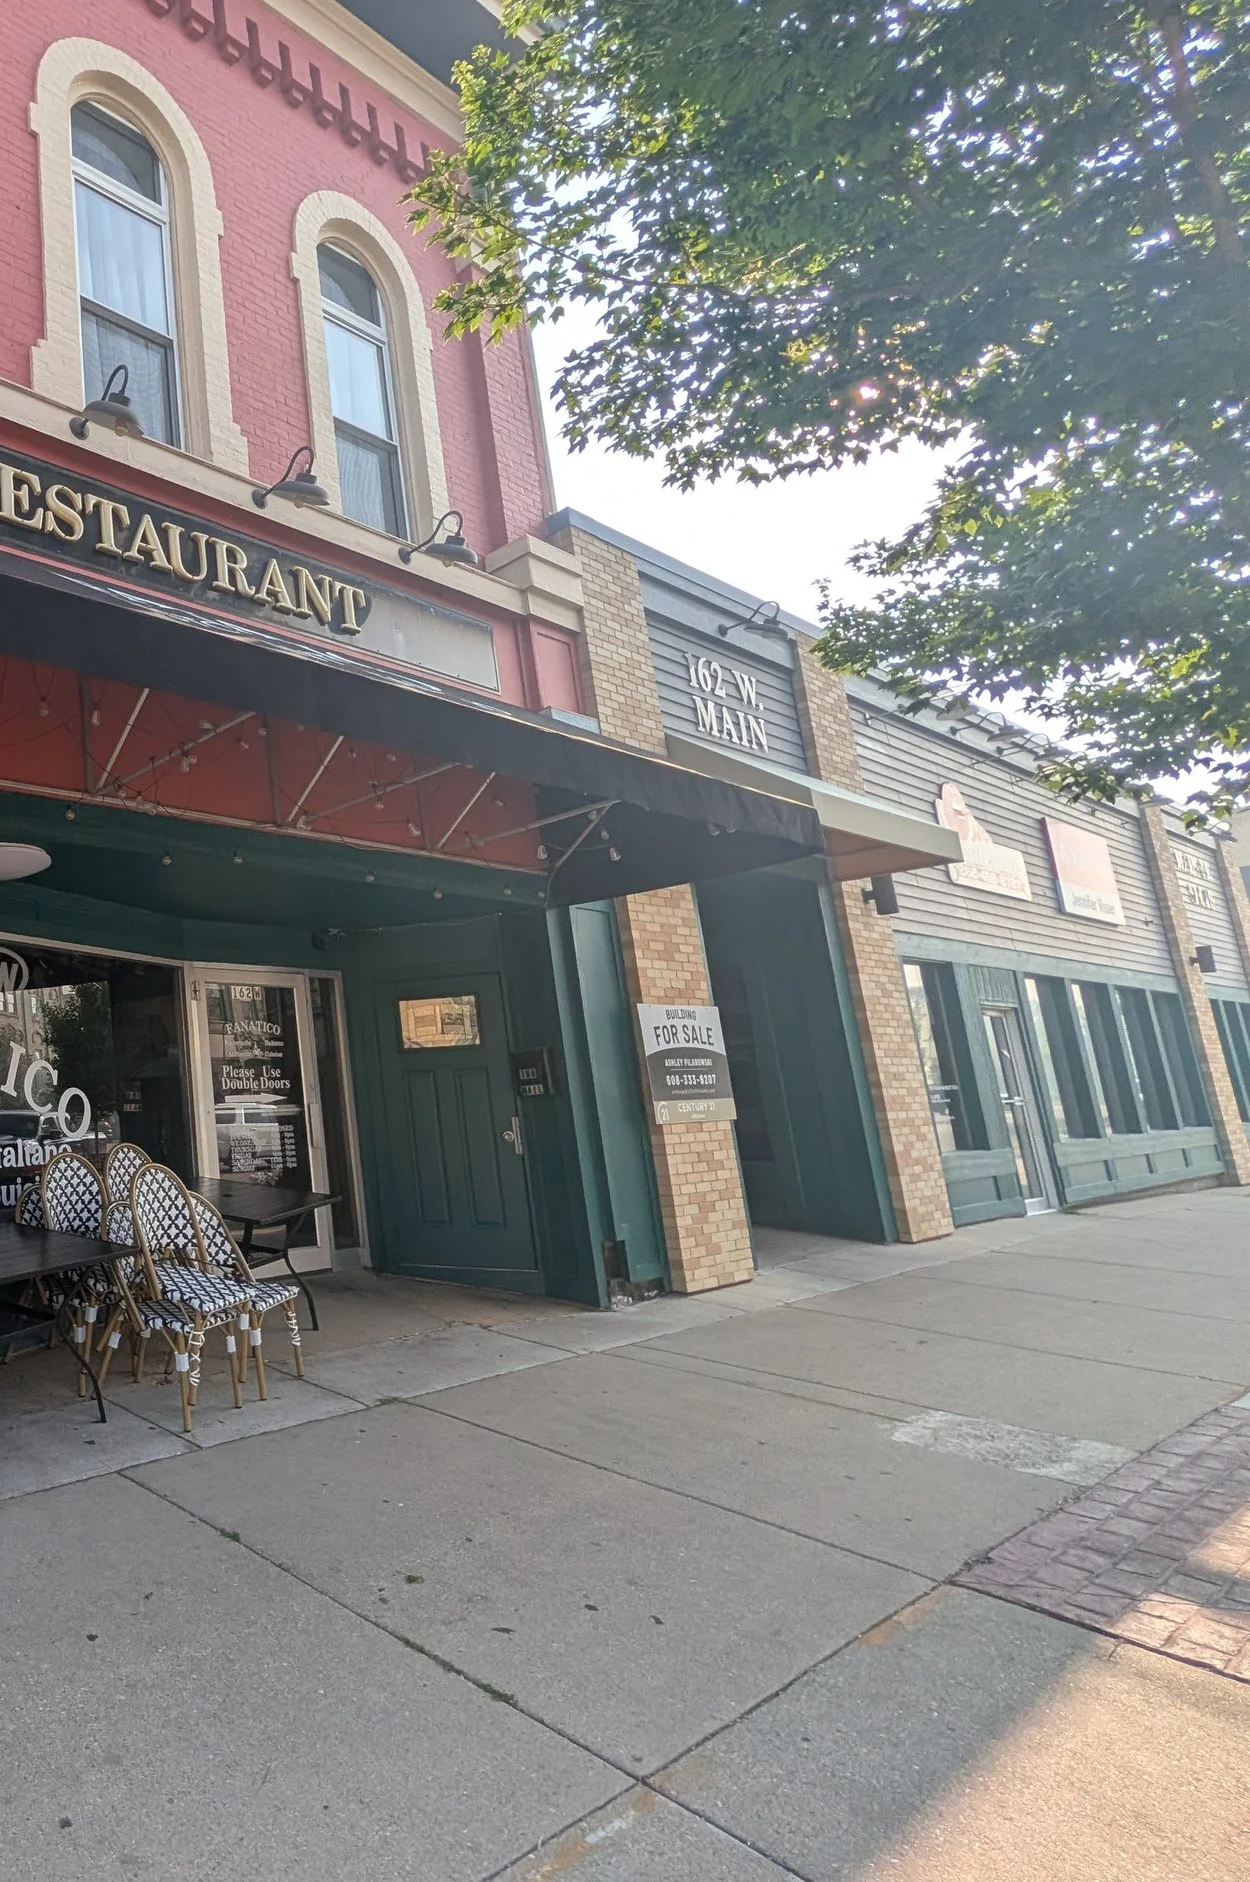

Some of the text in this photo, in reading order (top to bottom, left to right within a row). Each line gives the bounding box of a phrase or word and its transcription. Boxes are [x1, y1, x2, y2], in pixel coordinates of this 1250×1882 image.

[683, 652, 764, 712] 162 W.
[692, 695, 769, 753] MAIN
[232, 986, 262, 999] 162 W
[665, 1008, 697, 1021] BUILDING
[225, 1020, 281, 1036] FANATICO
[653, 1024, 714, 1047] FOR SALE
[665, 1058, 684, 1067] ASHLEY
[222, 1065, 281, 1078] Please Use
[221, 1077, 291, 1090] Double Doors
[678, 1102, 709, 1113] CENTURY
